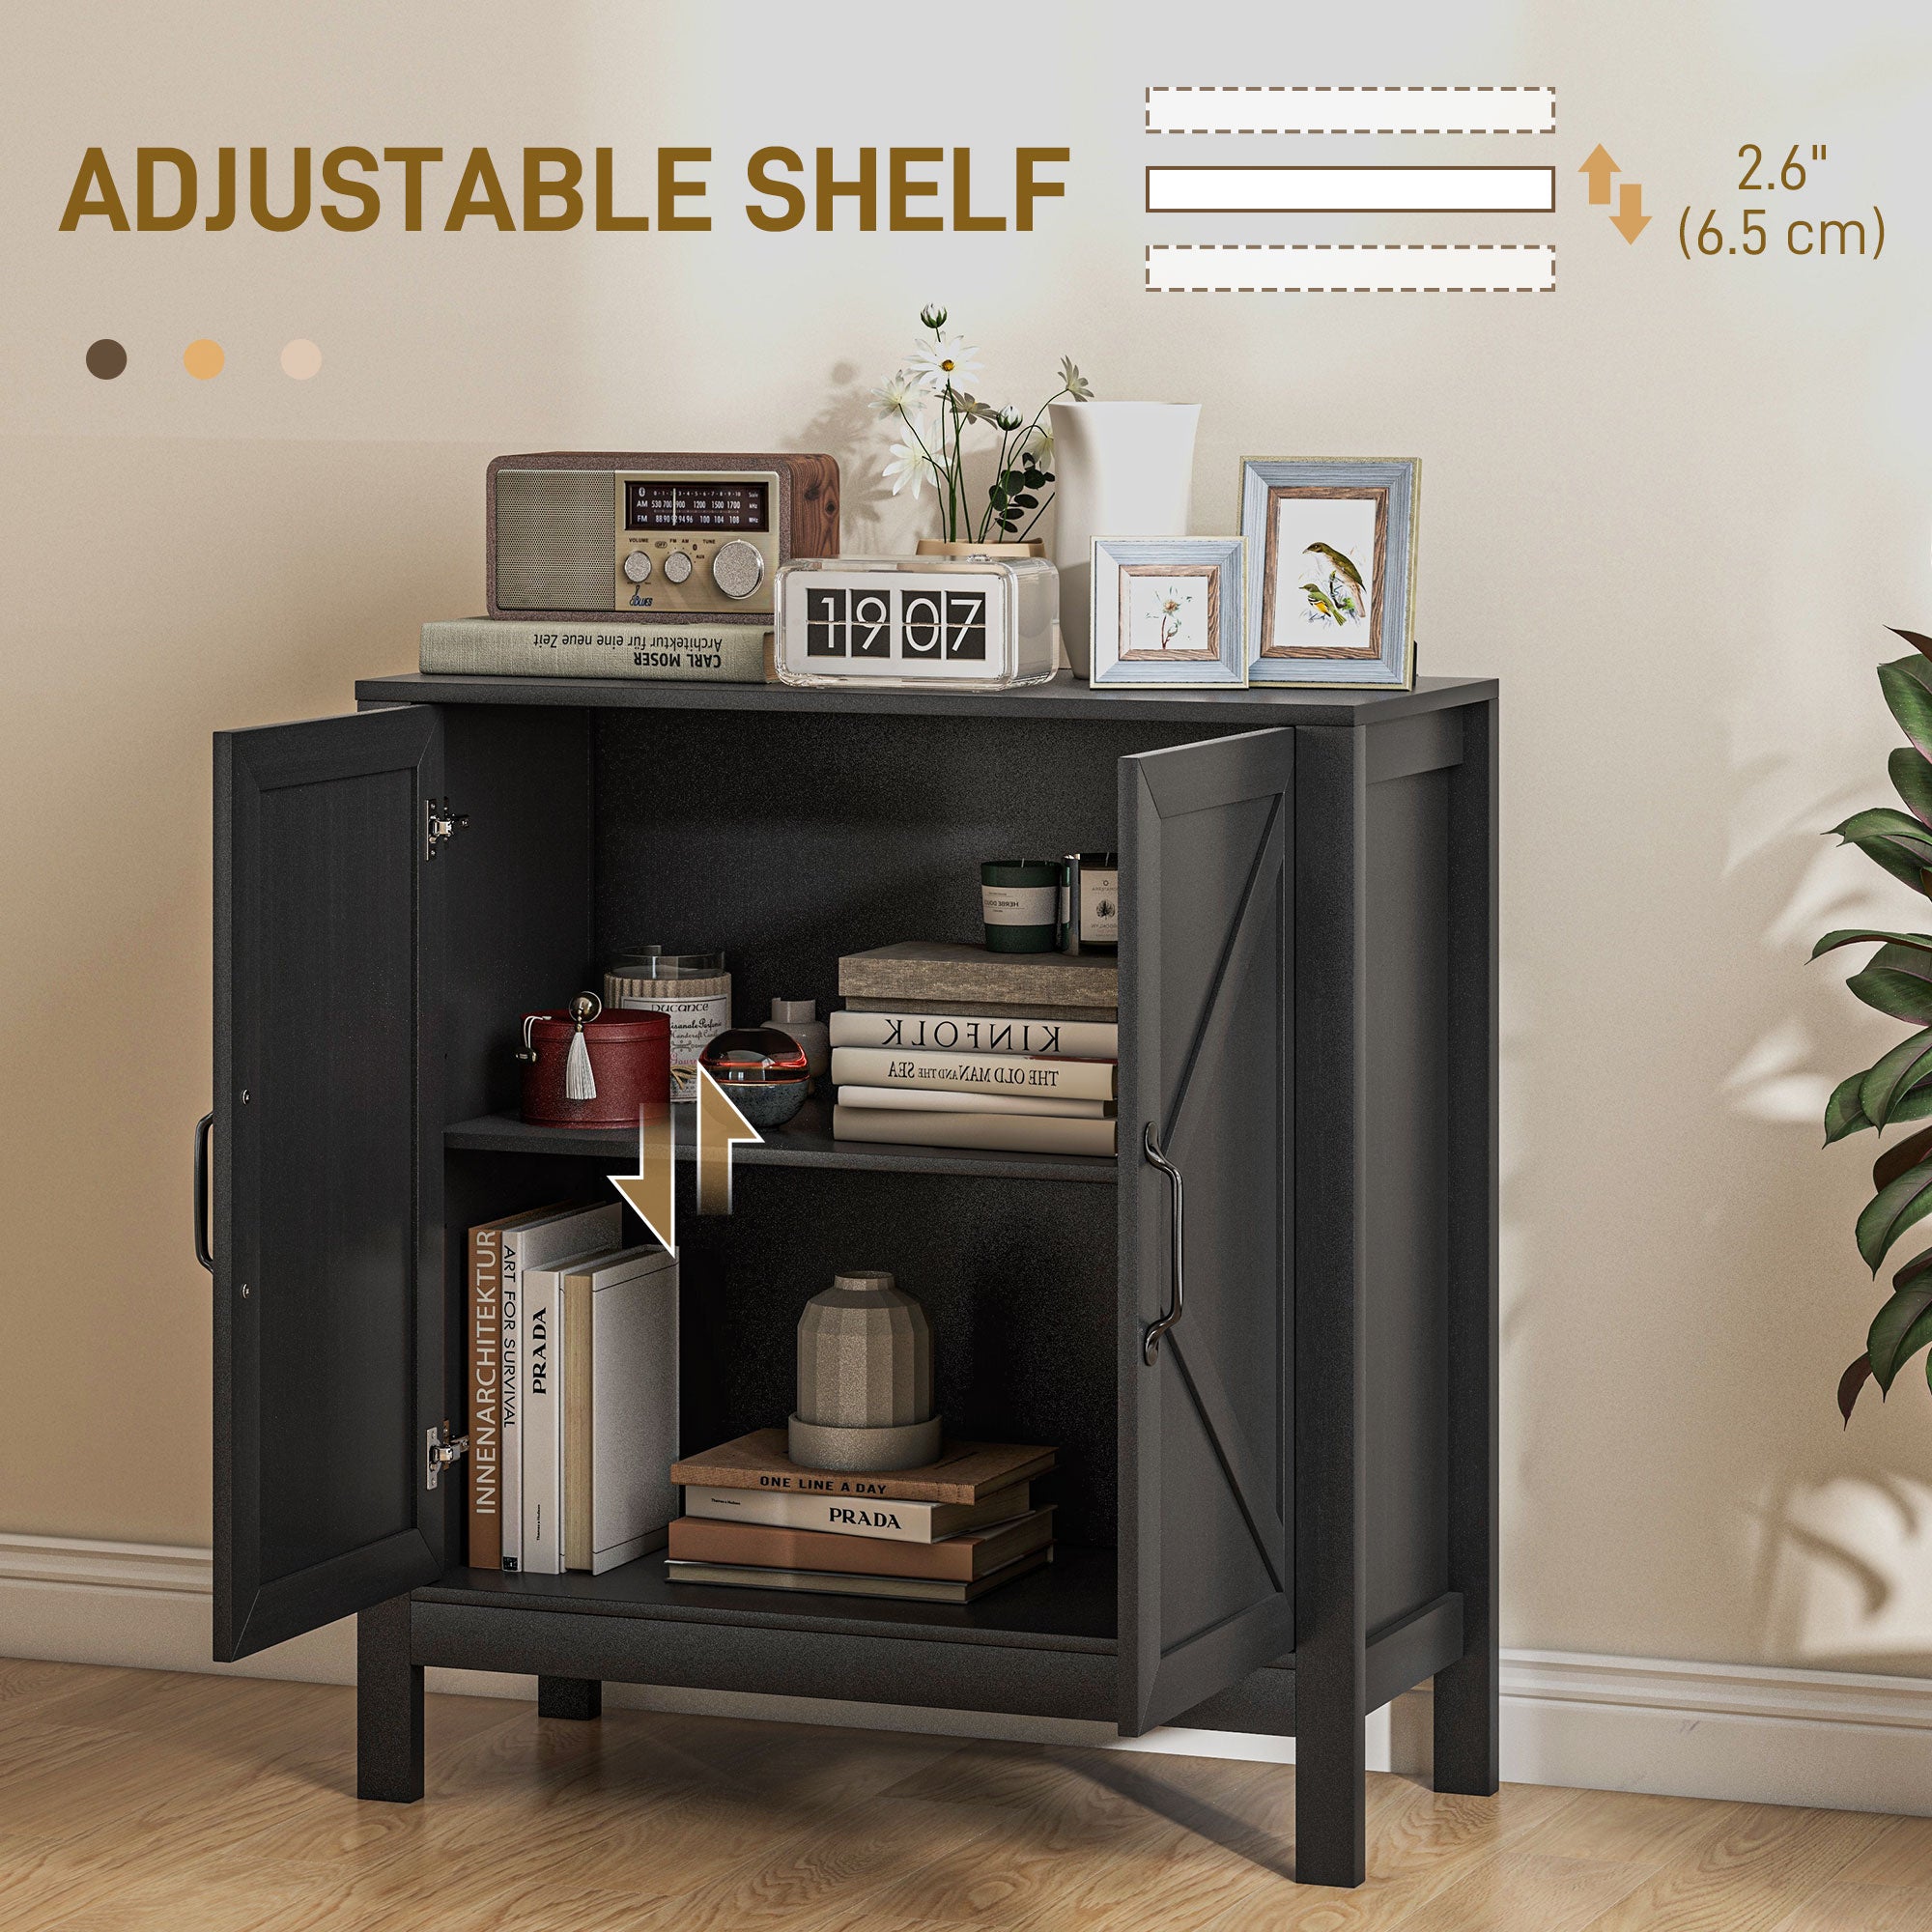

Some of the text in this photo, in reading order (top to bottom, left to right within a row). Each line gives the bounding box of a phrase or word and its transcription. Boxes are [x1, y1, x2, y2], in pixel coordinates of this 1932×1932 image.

[694, 500, 706, 509] 1200
[711, 500, 724, 509] 1500
[726, 500, 741, 509] 1700
[699, 515, 711, 524] 100
[714, 515, 724, 524] 104
[729, 515, 740, 524] 108
[533, 634, 723, 652] Architektur für eine neue Zeit
[634, 652, 722, 668] CARL MOSER
[503, 1244, 516, 1428] ART FOR SURVIVAL
[532, 1307, 547, 1395] PRADA
[476, 1231, 497, 1514] INNENARCHITEKTUR
[759, 1475, 888, 1495] ONE LINE A DAY
[829, 1507, 902, 1529] PRADA
